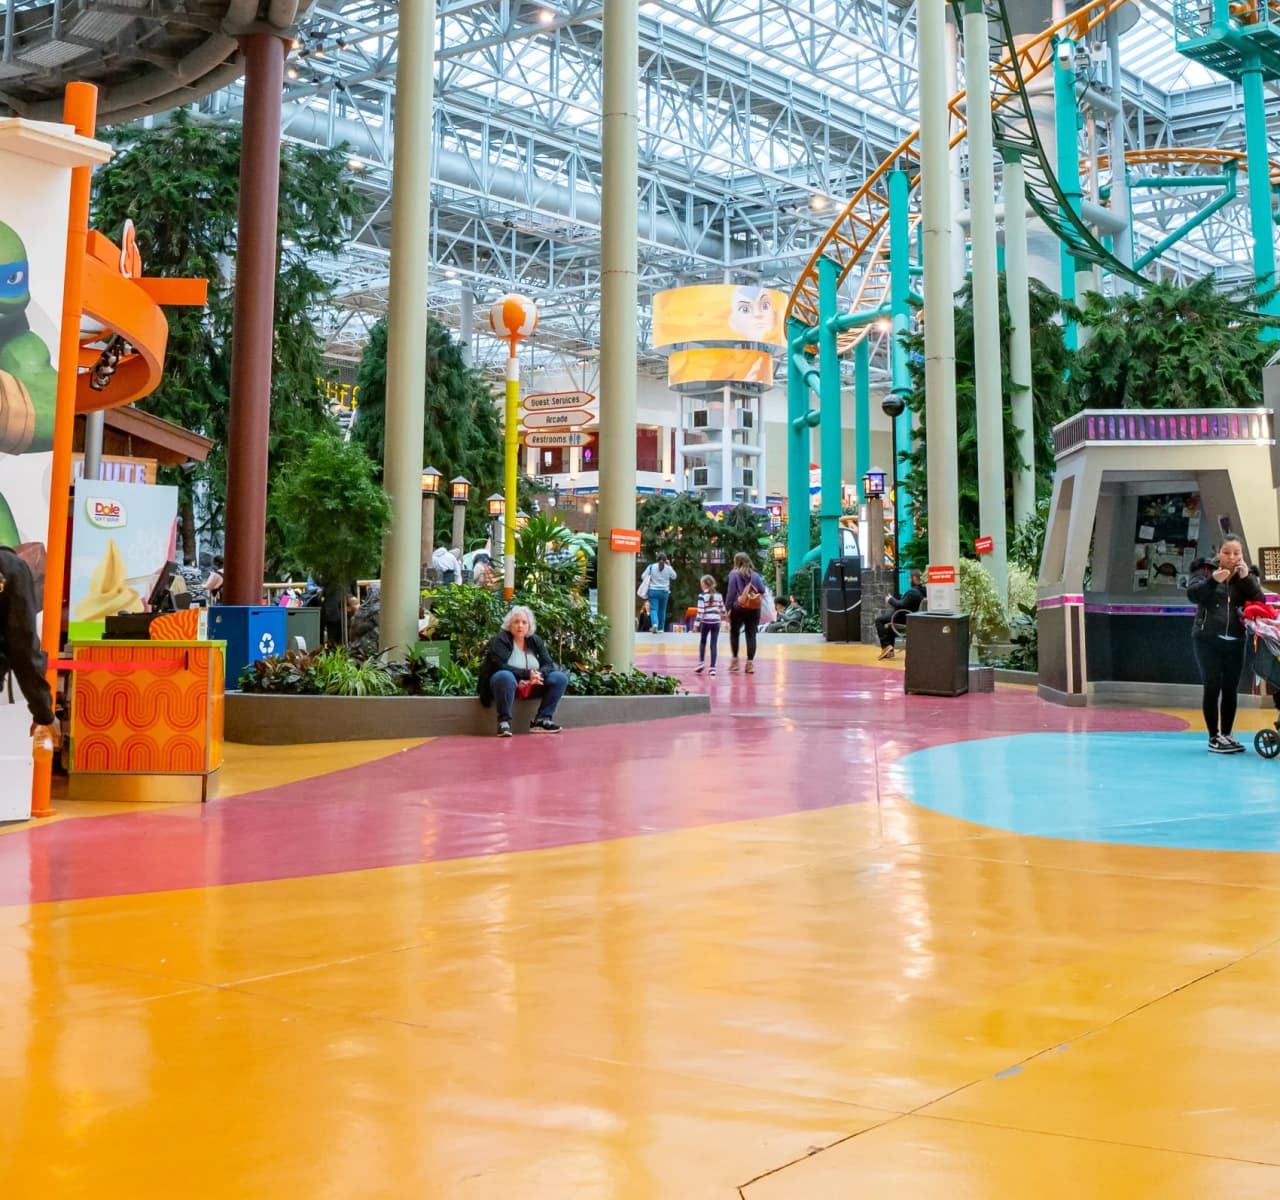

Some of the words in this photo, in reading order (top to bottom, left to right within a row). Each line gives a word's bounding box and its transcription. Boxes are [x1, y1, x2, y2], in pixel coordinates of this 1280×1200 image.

[531, 398, 550, 407] Guest
[552, 396, 580, 405] Services
[546, 415, 568, 424] Arcade
[95, 503, 120, 515] Dole
